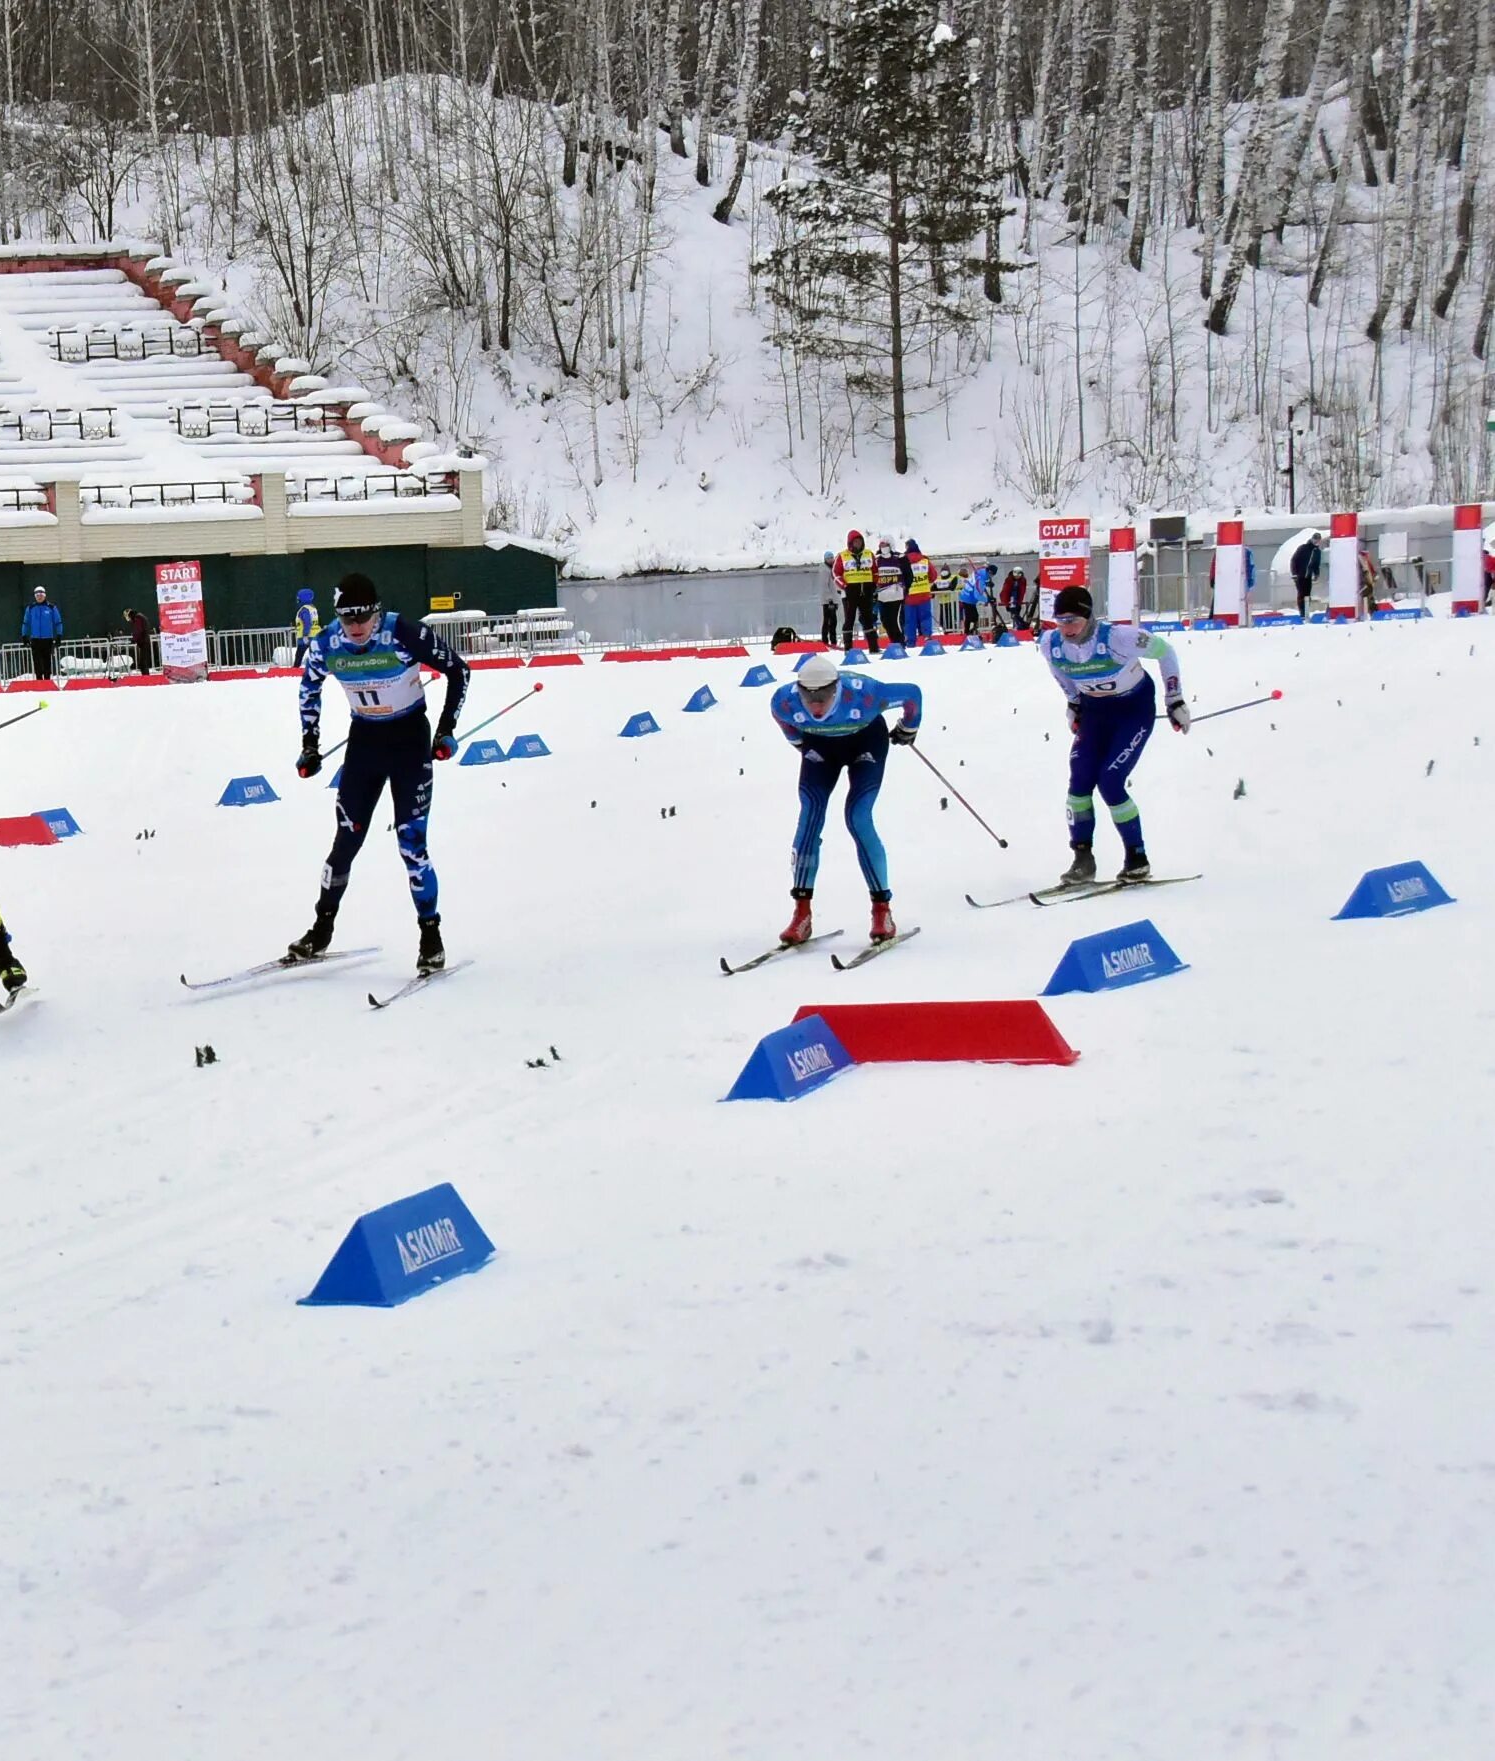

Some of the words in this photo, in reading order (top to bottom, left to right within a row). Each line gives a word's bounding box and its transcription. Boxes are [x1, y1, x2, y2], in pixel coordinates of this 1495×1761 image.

[1042, 524, 1080, 537] СТАРТ
[160, 567, 197, 581] START
[353, 689, 381, 706] 11
